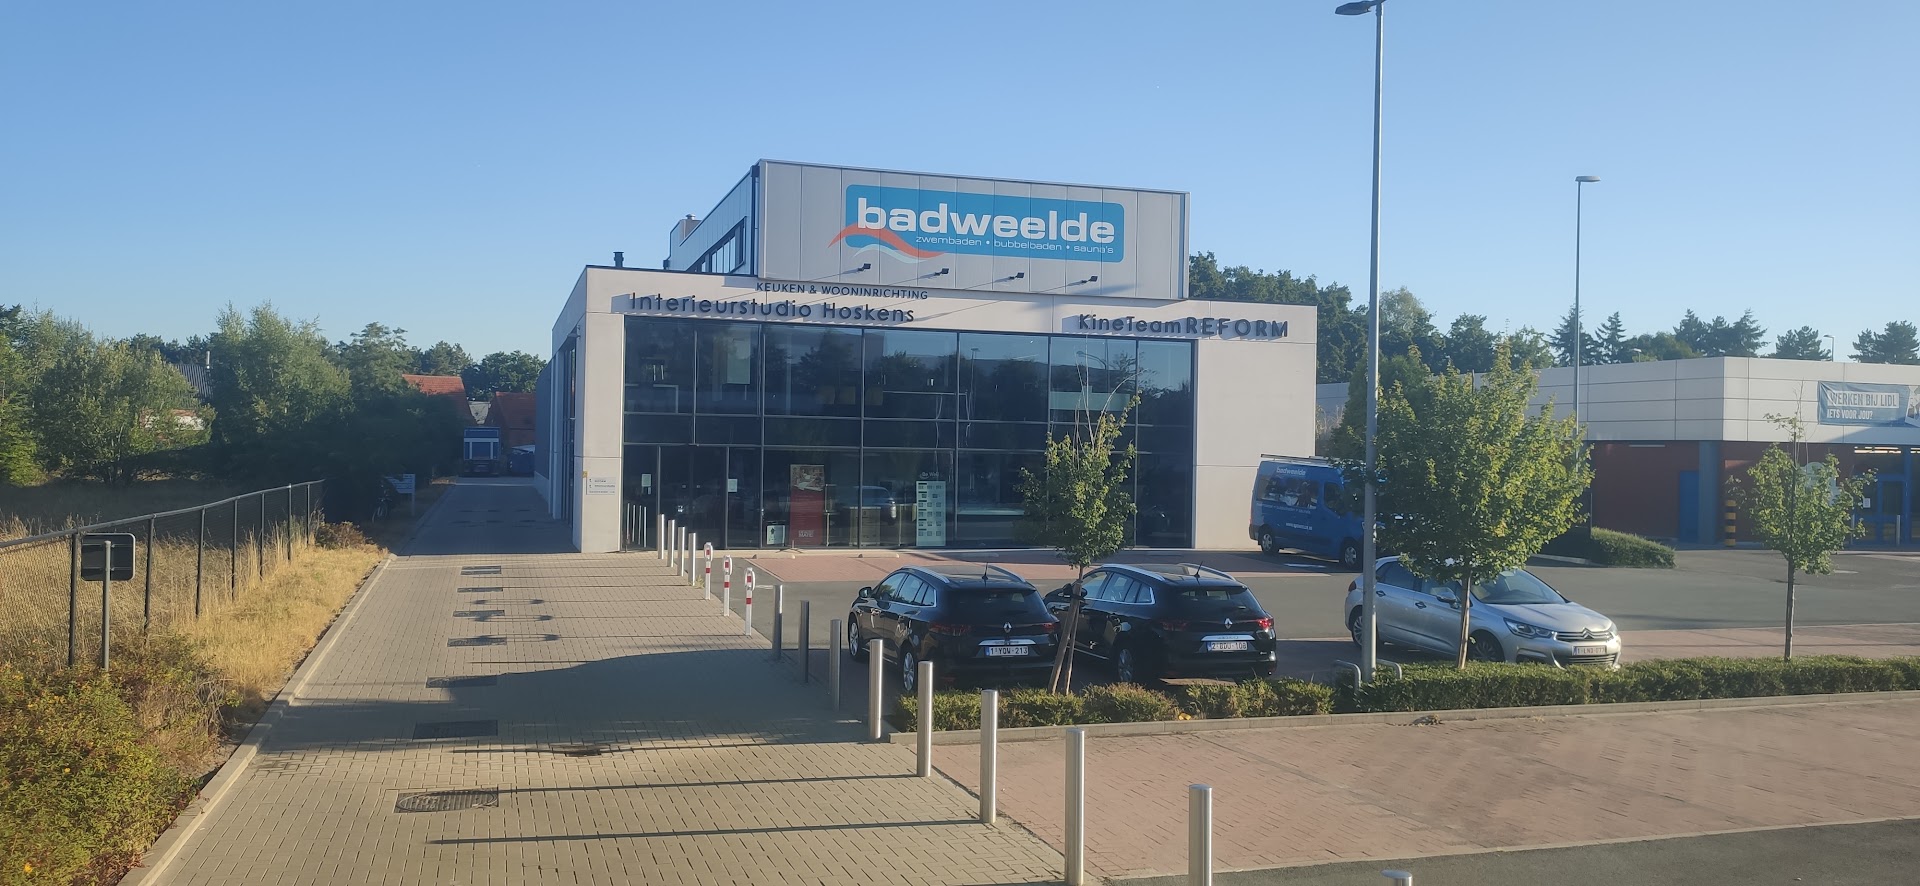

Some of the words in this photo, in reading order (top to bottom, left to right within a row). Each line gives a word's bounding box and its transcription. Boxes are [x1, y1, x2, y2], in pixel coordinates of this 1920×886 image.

[857, 197, 1115, 243] badweelde
[916, 236, 982, 246] zwembaden
[994, 239, 1062, 251] bubbelbaden
[1073, 245, 1114, 254] sauna's
[756, 282, 806, 294] KEUKEN
[809, 284, 818, 294] &
[821, 285, 928, 300] WOONINRICHTING
[631, 292, 812, 318] Interieurstudio
[823, 302, 915, 322] Hoskens
[1186, 316, 1288, 337] REFORM
[1831, 392, 1864, 406] WERKEN
[1866, 393, 1879, 406] BIJ
[1880, 394, 1897, 407] LIDL
[1827, 408, 1840, 419] IETS
[1841, 409, 1857, 419] VOOR
[1858, 410, 1873, 420] JOU?
[1276, 466, 1306, 476] badweelde
